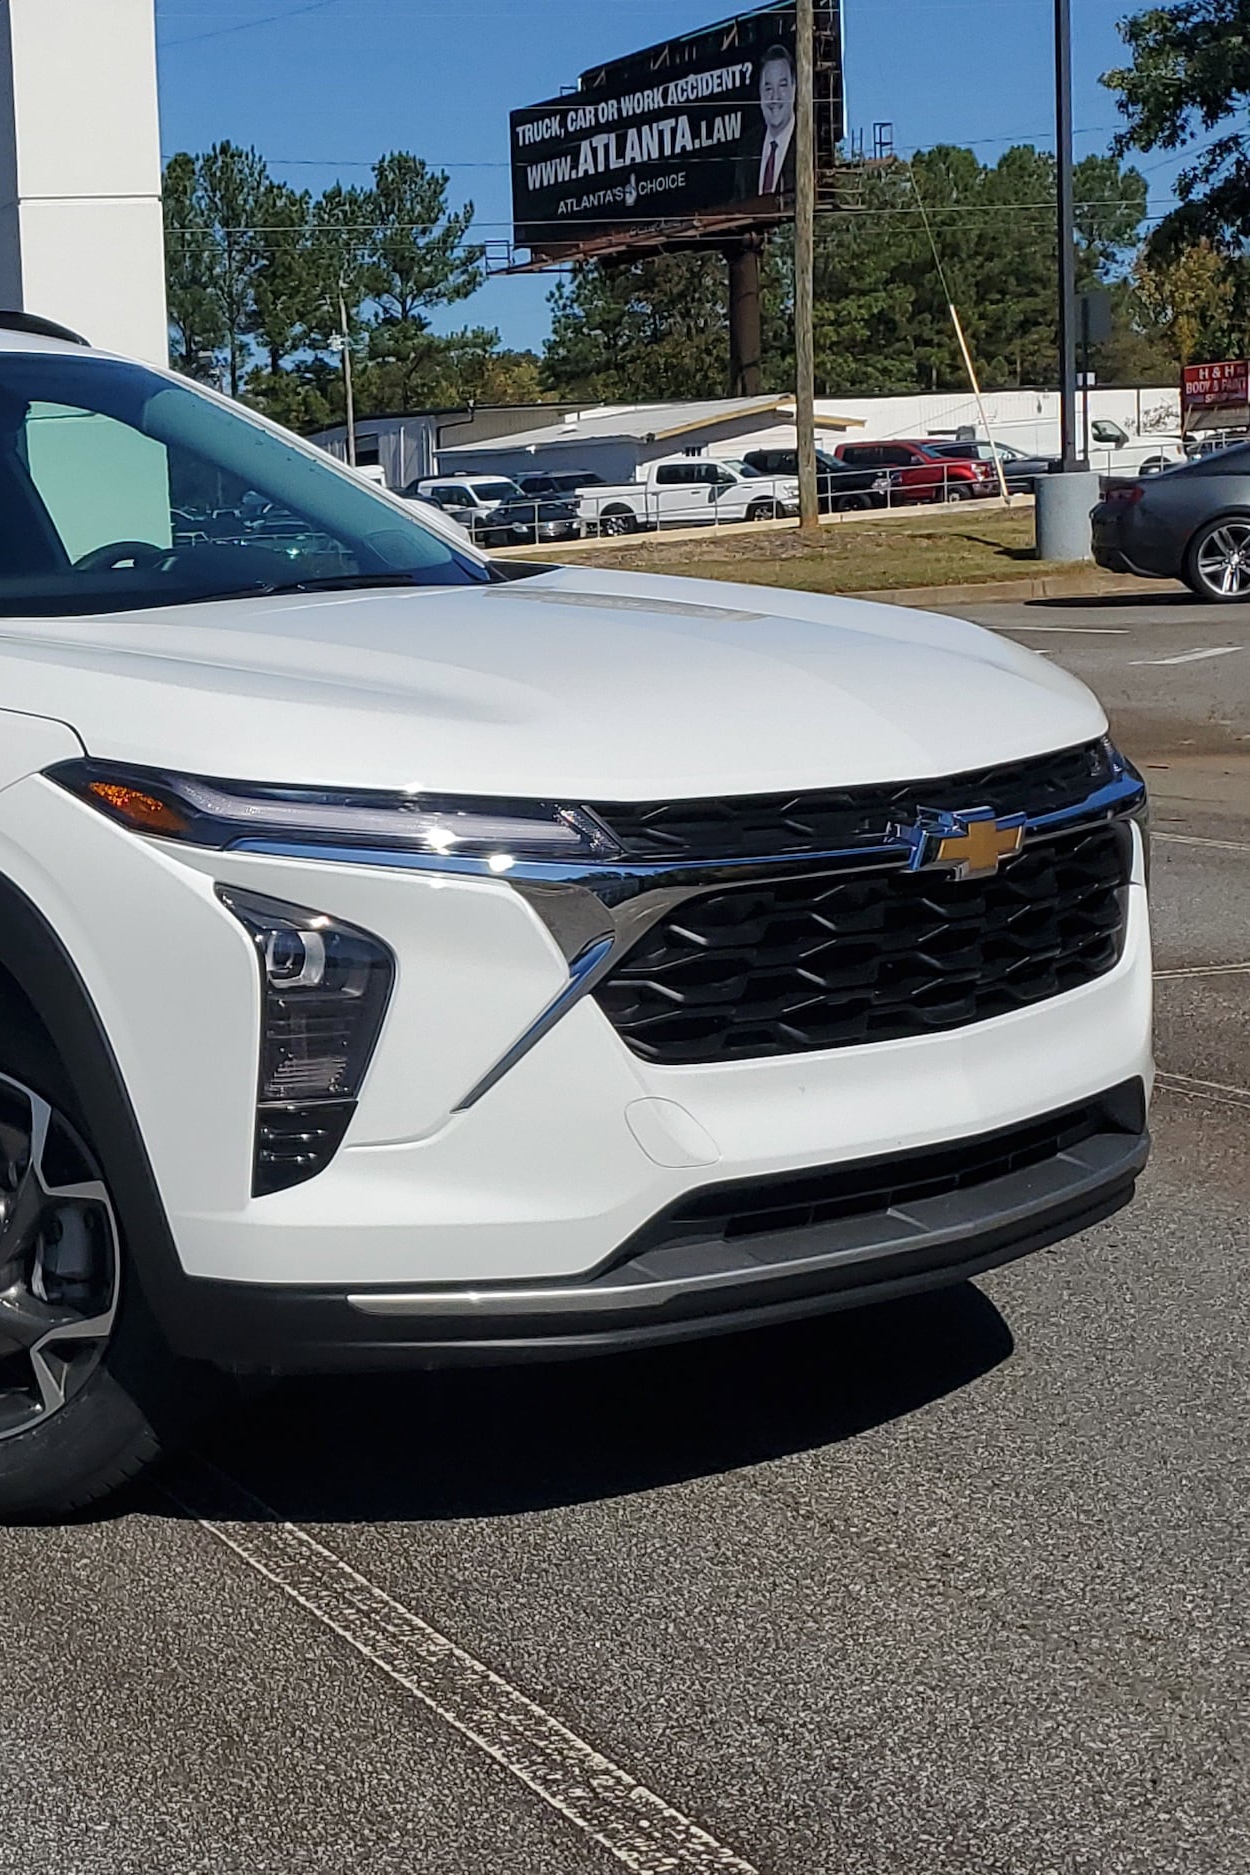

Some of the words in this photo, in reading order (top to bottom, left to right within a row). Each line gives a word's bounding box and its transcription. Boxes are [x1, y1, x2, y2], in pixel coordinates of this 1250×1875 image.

[516, 115, 564, 147] TRUCK,
[567, 107, 595, 133] CAR
[599, 100, 619, 124] OR
[621, 86, 665, 117] WORK
[667, 62, 753, 105] ACCIDENT?
[557, 186, 624, 215] ATLANTA'S
[638, 172, 687, 196] CHOICE
[1199, 367, 1209, 379] H
[1212, 366, 1221, 378] &
[1225, 364, 1235, 377] H
[1186, 380, 1211, 394] BODY
